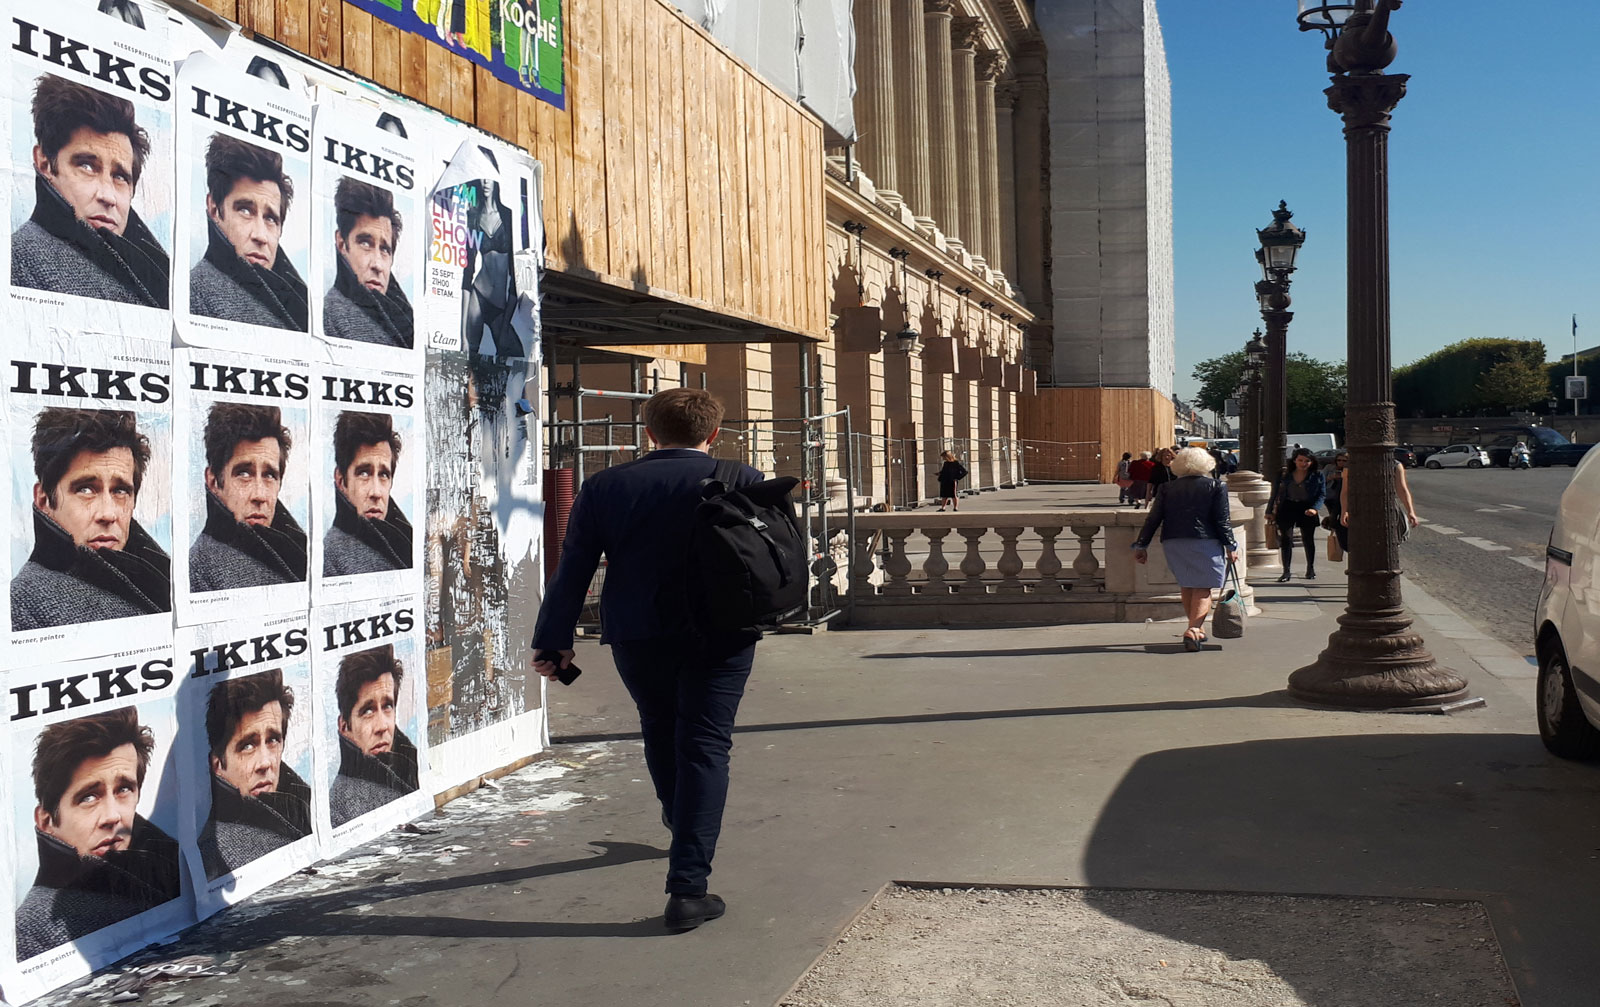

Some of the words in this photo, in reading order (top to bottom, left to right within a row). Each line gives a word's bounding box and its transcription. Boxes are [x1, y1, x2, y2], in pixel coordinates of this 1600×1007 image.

[499, 0, 558, 49] KOCHÉ
[12, 18, 170, 102] IKKS
[191, 86, 309, 152] IKKS
[323, 136, 414, 190] IKKS
[432, 218, 484, 250] SHOW
[432, 240, 468, 269] 2018
[432, 331, 457, 346] Etam
[10, 360, 170, 403] IKKS
[189, 361, 309, 400] IKKS
[322, 376, 414, 408] IKKS
[323, 608, 414, 652] IKKS
[189, 627, 308, 683] IKKS
[9, 657, 174, 722] IKKS
